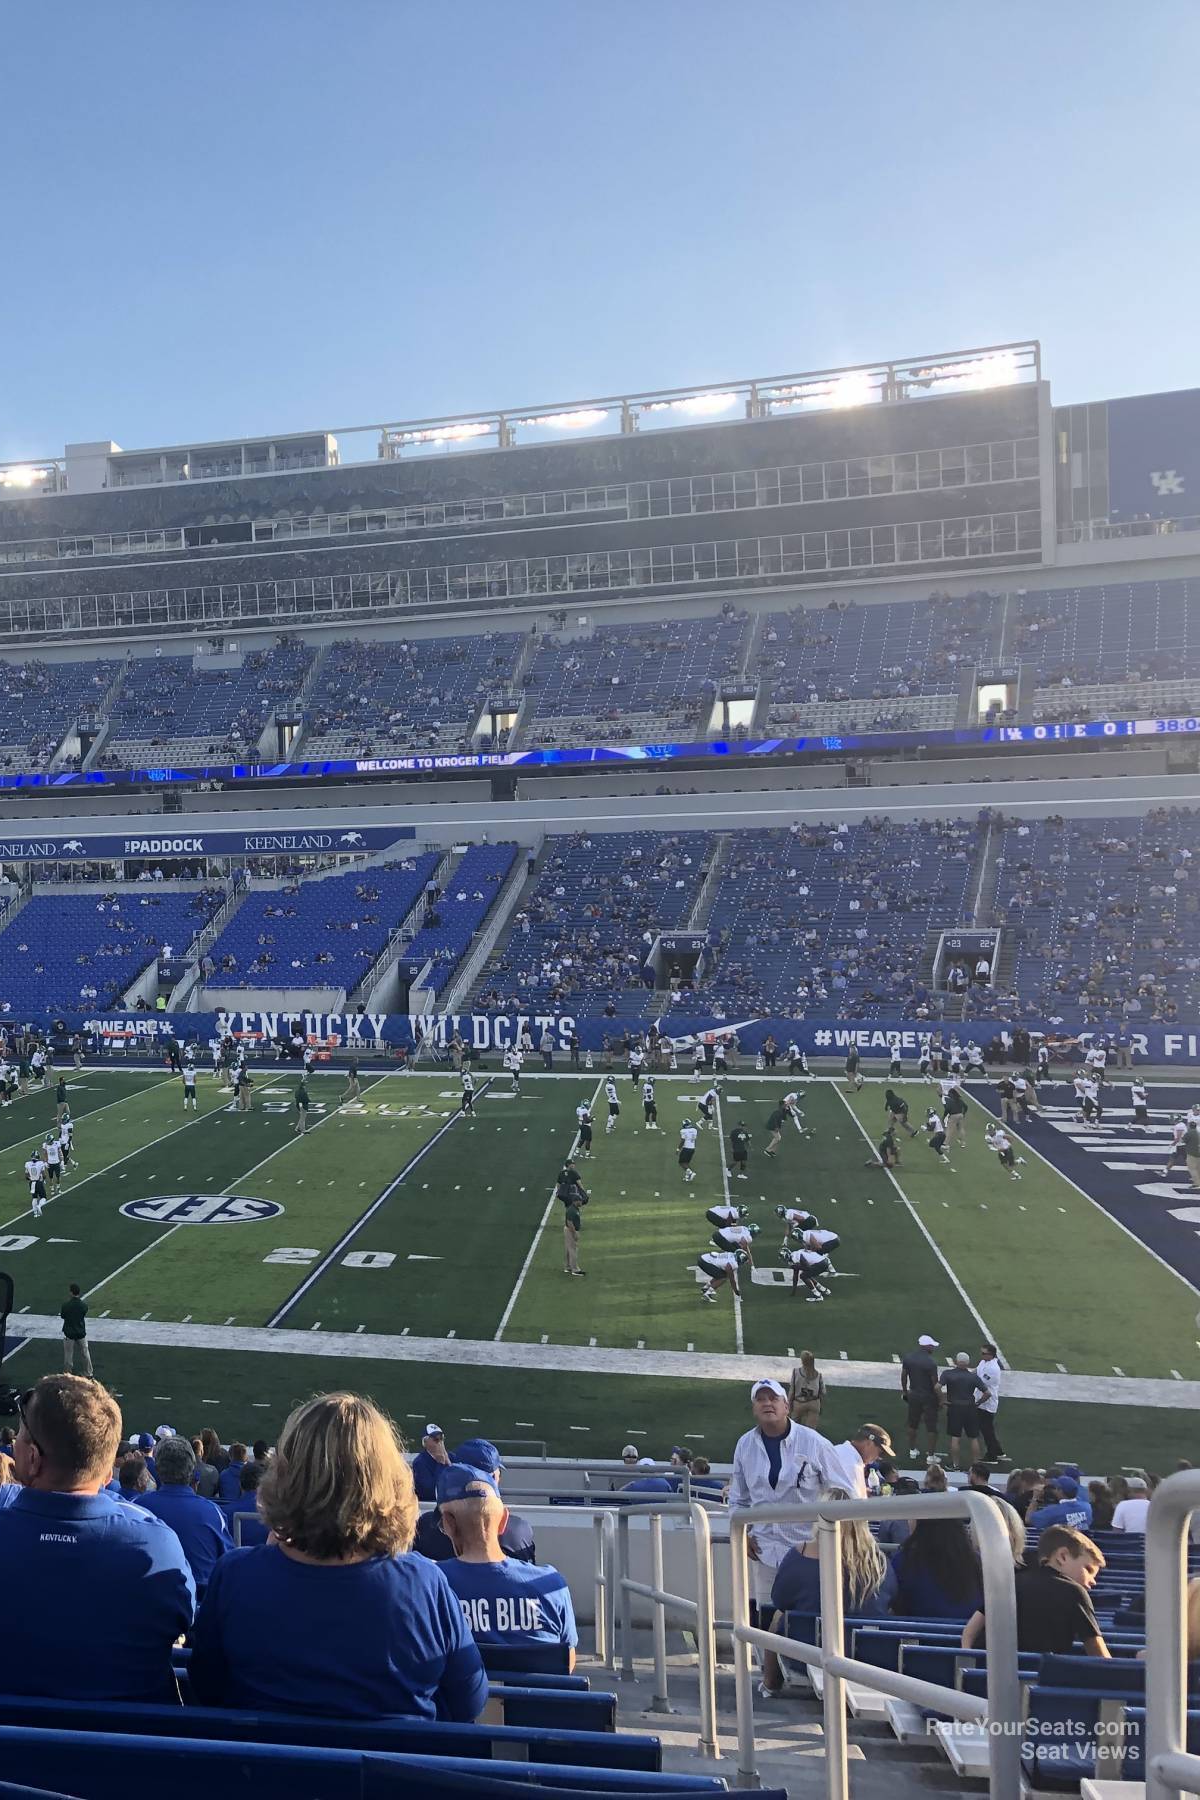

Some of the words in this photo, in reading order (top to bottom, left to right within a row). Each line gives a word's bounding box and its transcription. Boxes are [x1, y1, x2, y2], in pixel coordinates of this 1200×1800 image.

[1074, 724, 1086, 737] E
[1156, 719, 1200, 732] 38:0
[356, 758, 415, 771] WELCOME
[417, 758, 433, 768] TO
[435, 756, 480, 768] KROGER
[130, 838, 204, 854] PADDOCK
[244, 834, 332, 851] KEENELAND
[666, 941, 676, 949] 24
[951, 940, 961, 948] 23
[980, 939, 990, 948] 22
[218, 1012, 388, 1044] KENTUCKY
[408, 1013, 578, 1050] WILDCATS
[814, 1029, 916, 1048] #WEARE
[262, 1247, 397, 1268] 20
[40, 1533, 78, 1544] KENTUCKY
[460, 1598, 491, 1632] BIG
[496, 1597, 543, 1632] BLUE
